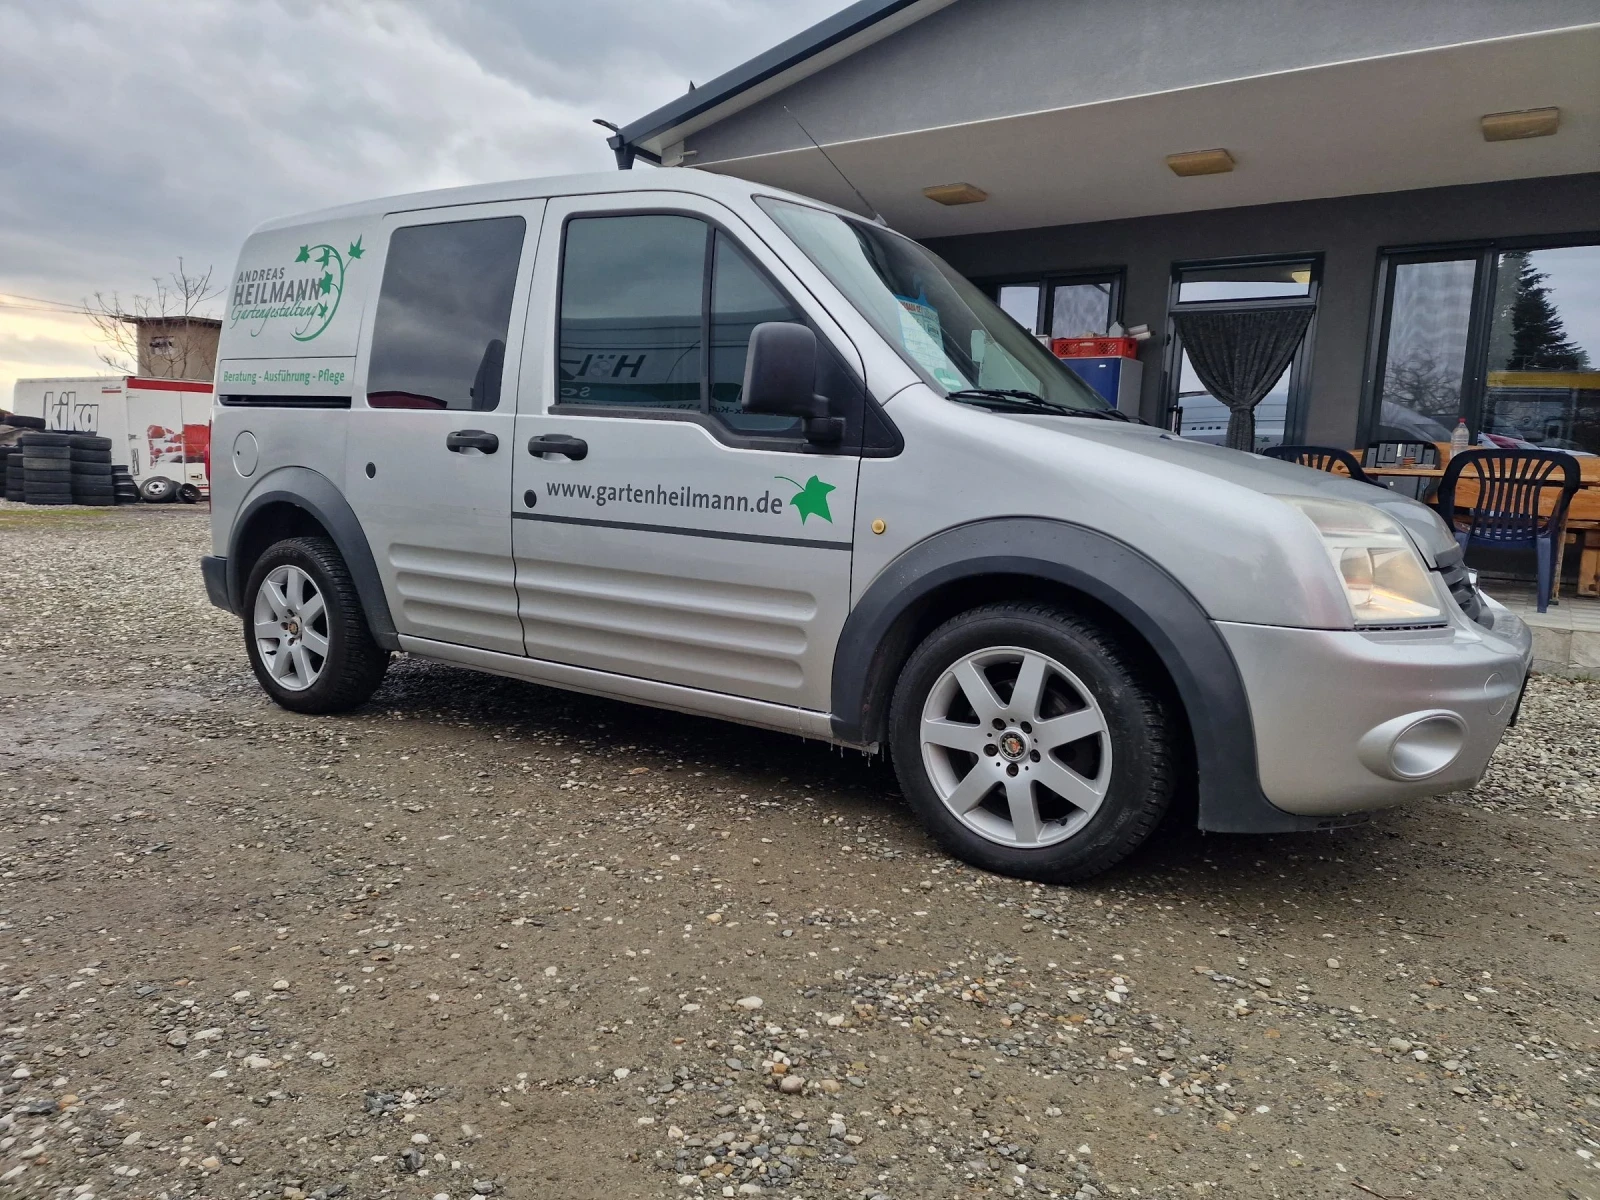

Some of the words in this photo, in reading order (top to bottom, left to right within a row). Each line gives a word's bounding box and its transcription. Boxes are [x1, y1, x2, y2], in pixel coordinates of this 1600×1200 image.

[237, 267, 285, 283] ANDREAS
[232, 278, 322, 306] HEILMANN
[223, 371, 257, 385] Beratung
[263, 369, 311, 386] Ausführung
[317, 368, 345, 386] Pflege
[43, 391, 99, 433] kika
[546, 481, 783, 515] www.gartenheilmann.de
